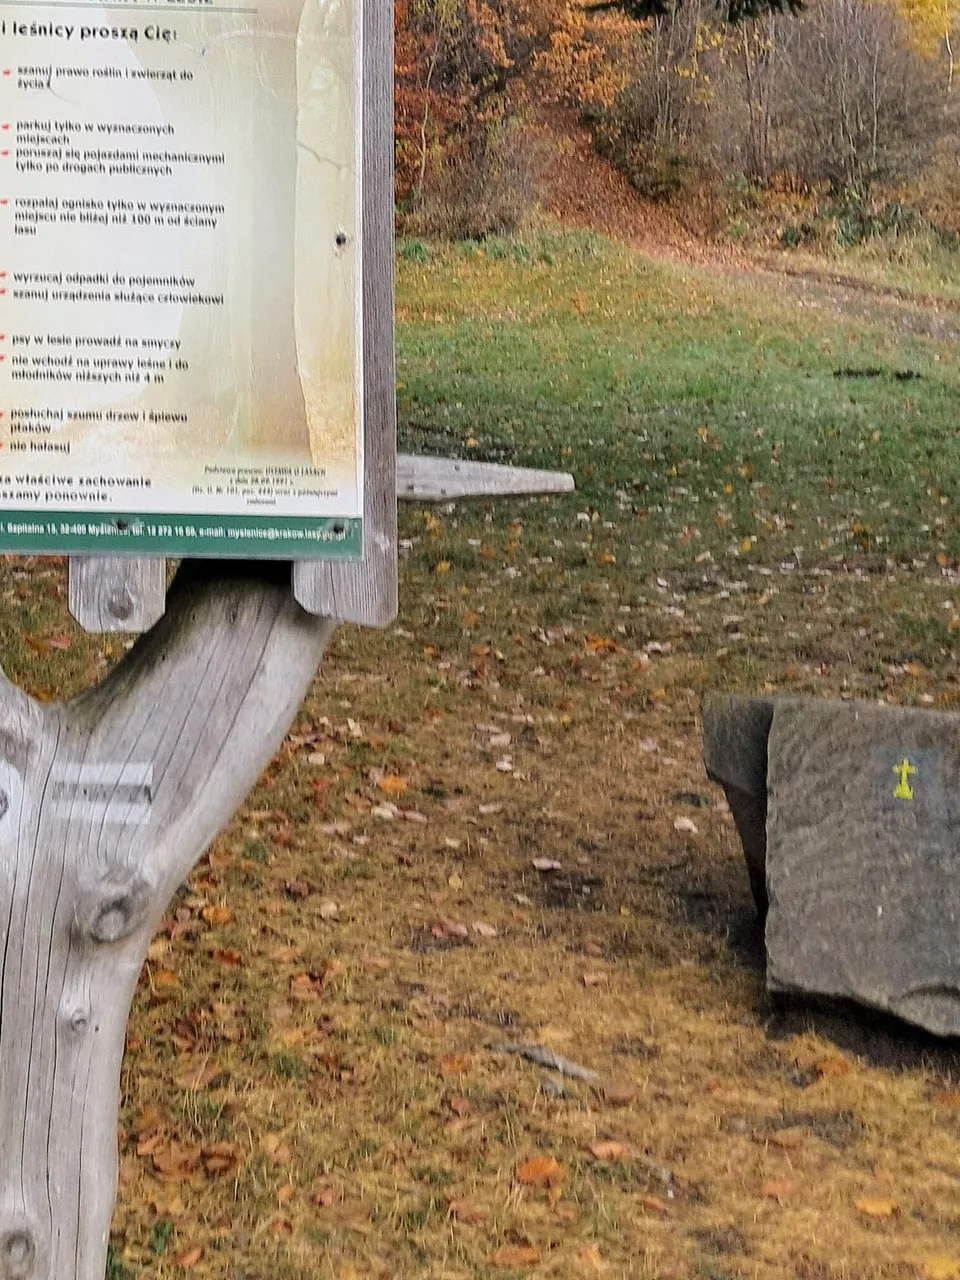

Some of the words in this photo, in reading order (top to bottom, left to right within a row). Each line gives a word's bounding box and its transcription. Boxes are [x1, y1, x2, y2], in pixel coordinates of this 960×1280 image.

[2, 20, 6, 34] i
[12, 20, 74, 39] leśnicy
[80, 25, 138, 44] proszą
[17, 64, 52, 78] szanuj
[55, 67, 89, 78] prawo
[92, 66, 123, 78] roślin
[131, 68, 177, 83] zwierząt
[180, 69, 194, 81] do
[17, 77, 44, 91] życia
[16, 120, 52, 134] parkuj
[54, 120, 81, 134] tylko
[84, 123, 94, 133] w
[96, 122, 175, 137] wyznaczonych
[16, 133, 70, 147] miejscach
[15, 147, 63, 160] poruszaj
[65, 148, 81, 161] się
[83, 149, 140, 162] pojazdami
[142, 151, 225, 165] mechanicznymi
[15, 160, 43, 173] tylko
[45, 163, 59, 175] po
[62, 161, 106, 176] drogach
[108, 163, 173, 178] publicznych
[15, 196, 59, 210] rozpalaj
[61, 197, 104, 211] ognisko
[107, 199, 134, 212] tylko
[136, 201, 146, 211] w
[149, 201, 225, 216] wyznaczonym
[14, 210, 57, 223] miejscu
[59, 211, 76, 223] nie
[79, 211, 109, 227] bliżej
[111, 213, 128, 225] niż
[130, 214, 151, 226] 100
[154, 216, 165, 227] m
[167, 215, 181, 227] od
[183, 215, 218, 231] ściany
[14, 223, 37, 236] lasu
[13, 271, 63, 286] wyrzucaj
[65, 272, 109, 286] odpadki
[112, 273, 126, 285] do
[128, 274, 196, 289] pojemników
[13, 288, 49, 302] szanuj
[51, 289, 111, 304] urządzenia
[114, 290, 155, 305] służące
[157, 291, 225, 306] człowiekowi
[11, 334, 31, 348] psy
[33, 335, 43, 346] w
[46, 334, 72, 347] lesie
[75, 334, 122, 348] prowadź
[125, 337, 139, 348] na
[141, 337, 182, 351] smyczy
[11, 354, 29, 366] nie
[31, 355, 73, 368] wchodź
[76, 357, 90, 368] na
[93, 358, 134, 370] uprawy
[137, 357, 166, 370] leśne
[175, 358, 189, 370] do
[11, 369, 72, 382] młodników
[75, 370, 122, 384] niższych
[125, 371, 141, 384] niż
[143, 372, 151, 383] 4
[154, 373, 165, 384] m
[10, 407, 64, 422] posłuchaj
[67, 410, 103, 422] szumu
[105, 409, 139, 423] drzew
[148, 409, 188, 424] śpiewu
[10, 421, 51, 435] ptaków
[10, 439, 27, 452] nie
[30, 440, 71, 455] hałasuj
[15, 473, 74, 487] właściwe
[78, 474, 152, 489] zachowanie
[45, 490, 113, 504] ponownie.
[7, 522, 44, 536] Szpitalna
